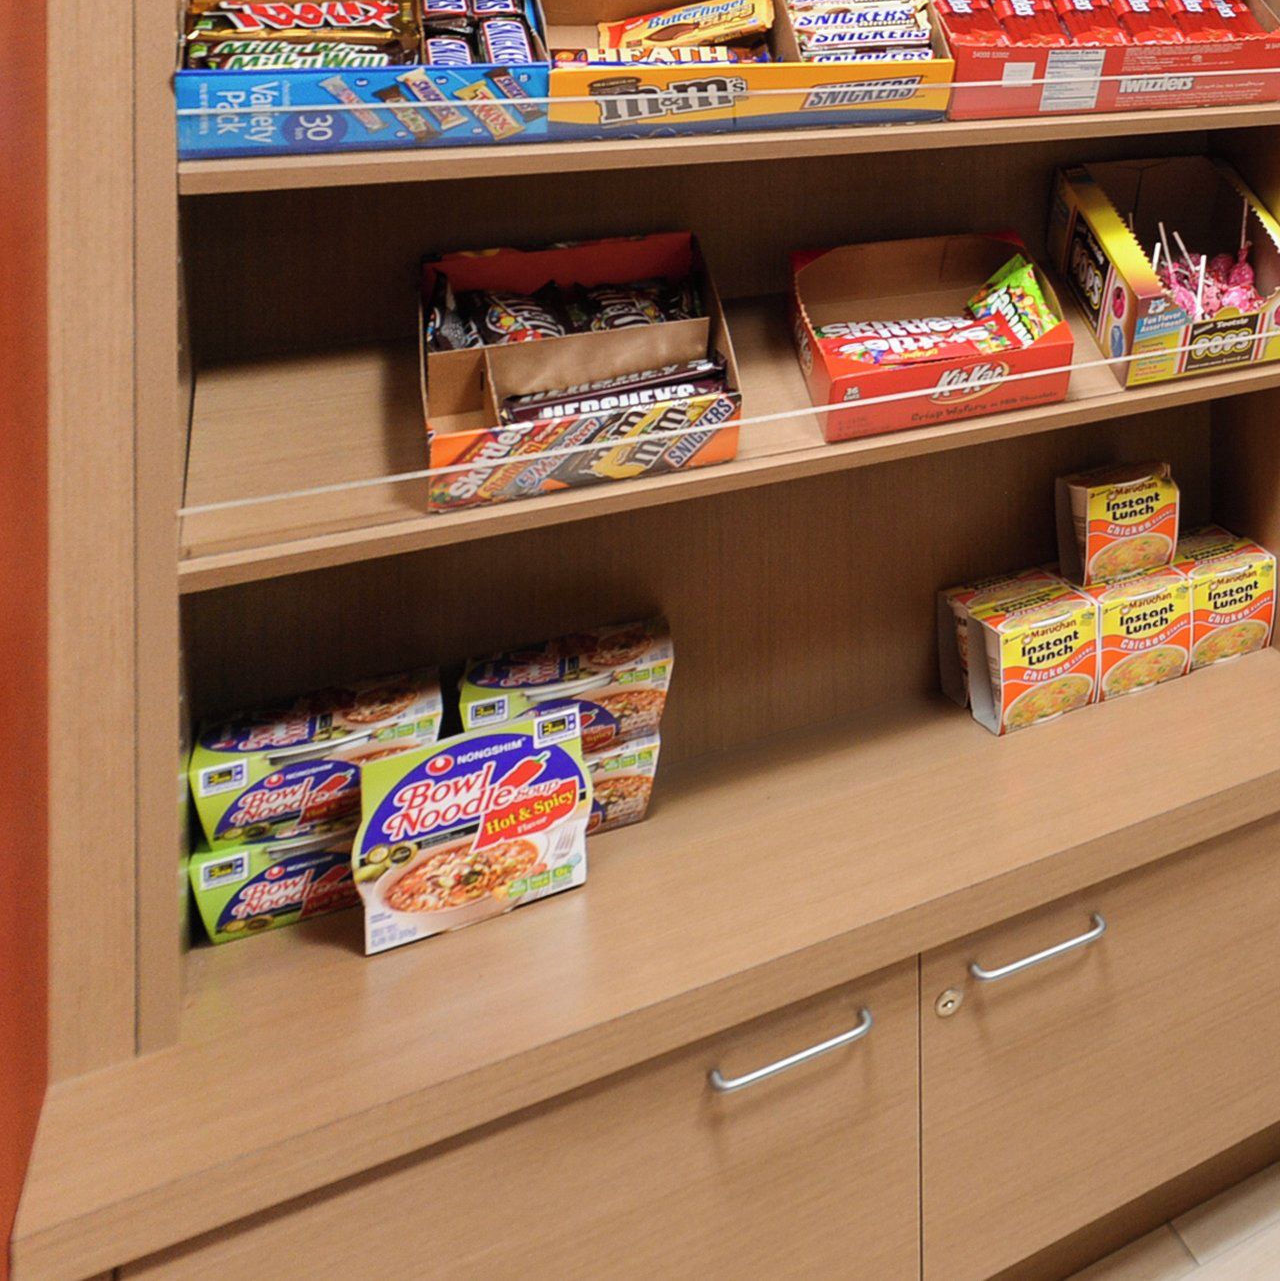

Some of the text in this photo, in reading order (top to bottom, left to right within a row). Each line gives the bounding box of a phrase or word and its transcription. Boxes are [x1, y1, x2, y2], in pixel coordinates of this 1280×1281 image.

[203, 0, 400, 32] TWIX
[799, 8, 915, 27] SNICKERS
[1118, 74, 1196, 94] Twizzlers
[215, 89, 246, 135] Pack
[245, 82, 278, 144] Variety
[299, 114, 334, 143] 30
[1216, 317, 1250, 330] Tootsie
[1193, 329, 1252, 356] POPS
[1114, 480, 1159, 496] Maruchan
[1106, 493, 1160, 514] Instant
[1112, 504, 1155, 521] Lunch
[1107, 521, 1151, 536] Chicken
[1128, 592, 1172, 610] Maruchan
[1207, 580, 1259, 603] Instant
[1213, 593, 1253, 611] Lunch
[1120, 603, 1175, 627] Instant
[1125, 616, 1169, 636] Lunch
[1207, 606, 1249, 624] Chicken
[1030, 618, 1077, 638] Maruchan
[1021, 630, 1079, 657] Instant
[1120, 631, 1166, 650] Chicken
[1028, 644, 1074, 667] Lunch
[1022, 662, 1070, 681] Chicken
[457, 738, 525, 765] NONGSHIM
[238, 776, 316, 808] Bowl
[393, 761, 497, 810] Bowl
[382, 784, 515, 841] Noodle
[486, 789, 575, 836] Hot & Spicy
[517, 817, 549, 834] Flavor
[239, 869, 316, 902] Bowl
